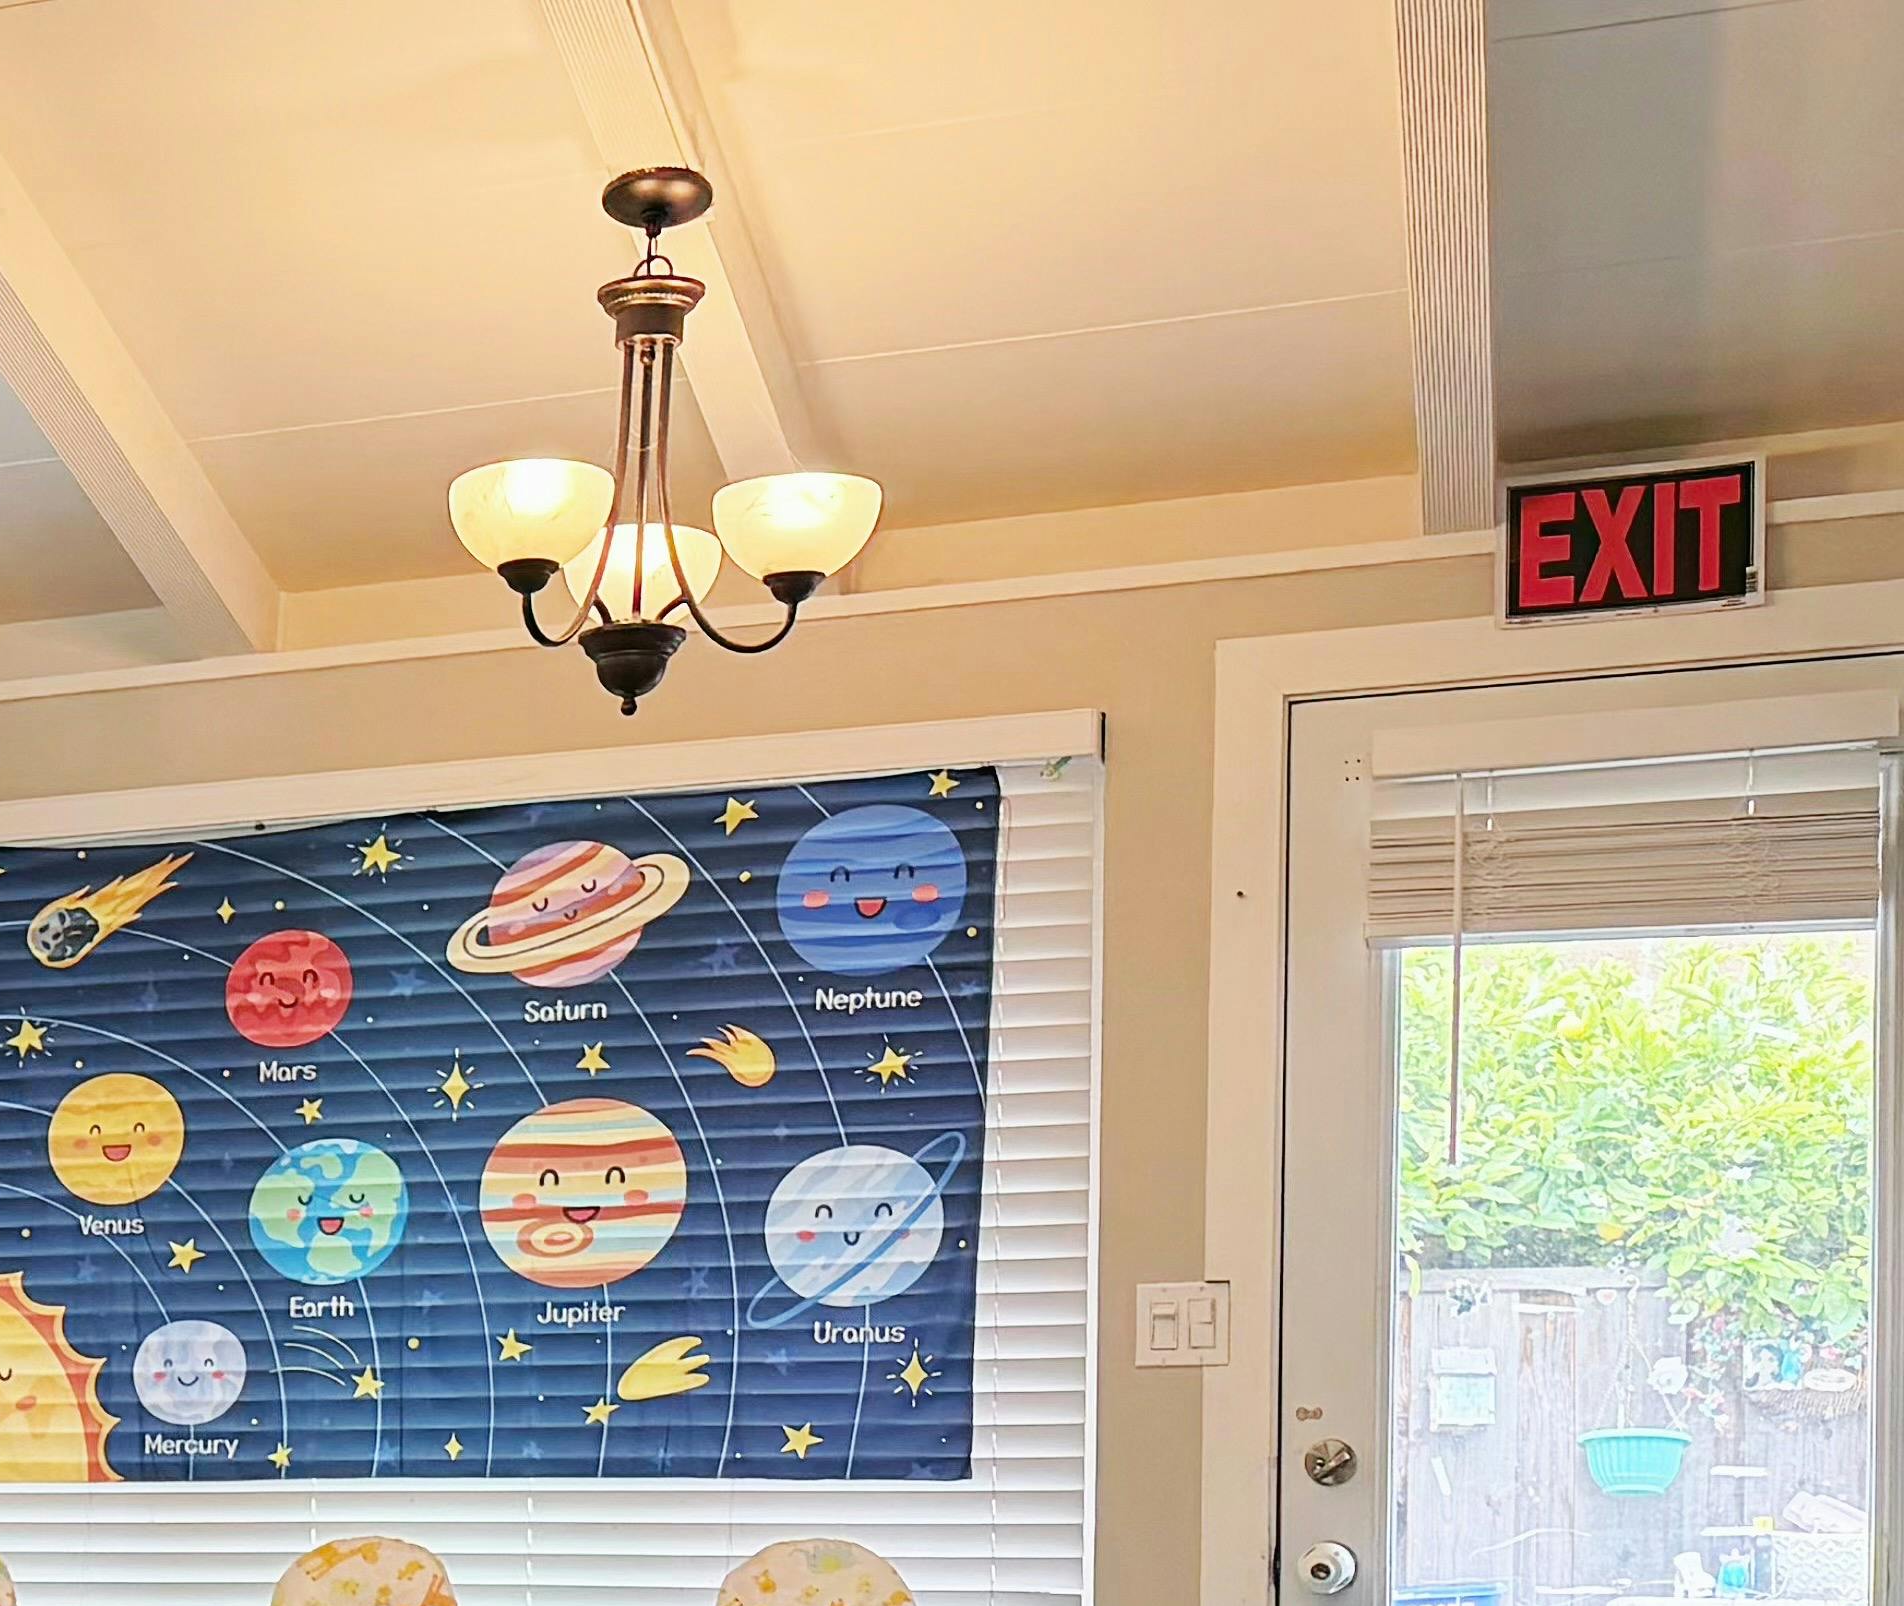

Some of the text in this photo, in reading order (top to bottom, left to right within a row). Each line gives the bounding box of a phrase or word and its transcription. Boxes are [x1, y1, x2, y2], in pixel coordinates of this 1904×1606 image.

[1519, 474, 1741, 608] EXIT
[523, 999, 608, 1023] Saturn
[815, 987, 923, 1014] Neptune
[259, 1061, 317, 1083] Mars
[80, 1214, 145, 1237] Venus
[289, 1295, 355, 1318] Earth
[537, 1300, 626, 1327] Jupiter
[813, 1321, 906, 1344] Uranus
[144, 1433, 239, 1459] Mercury
